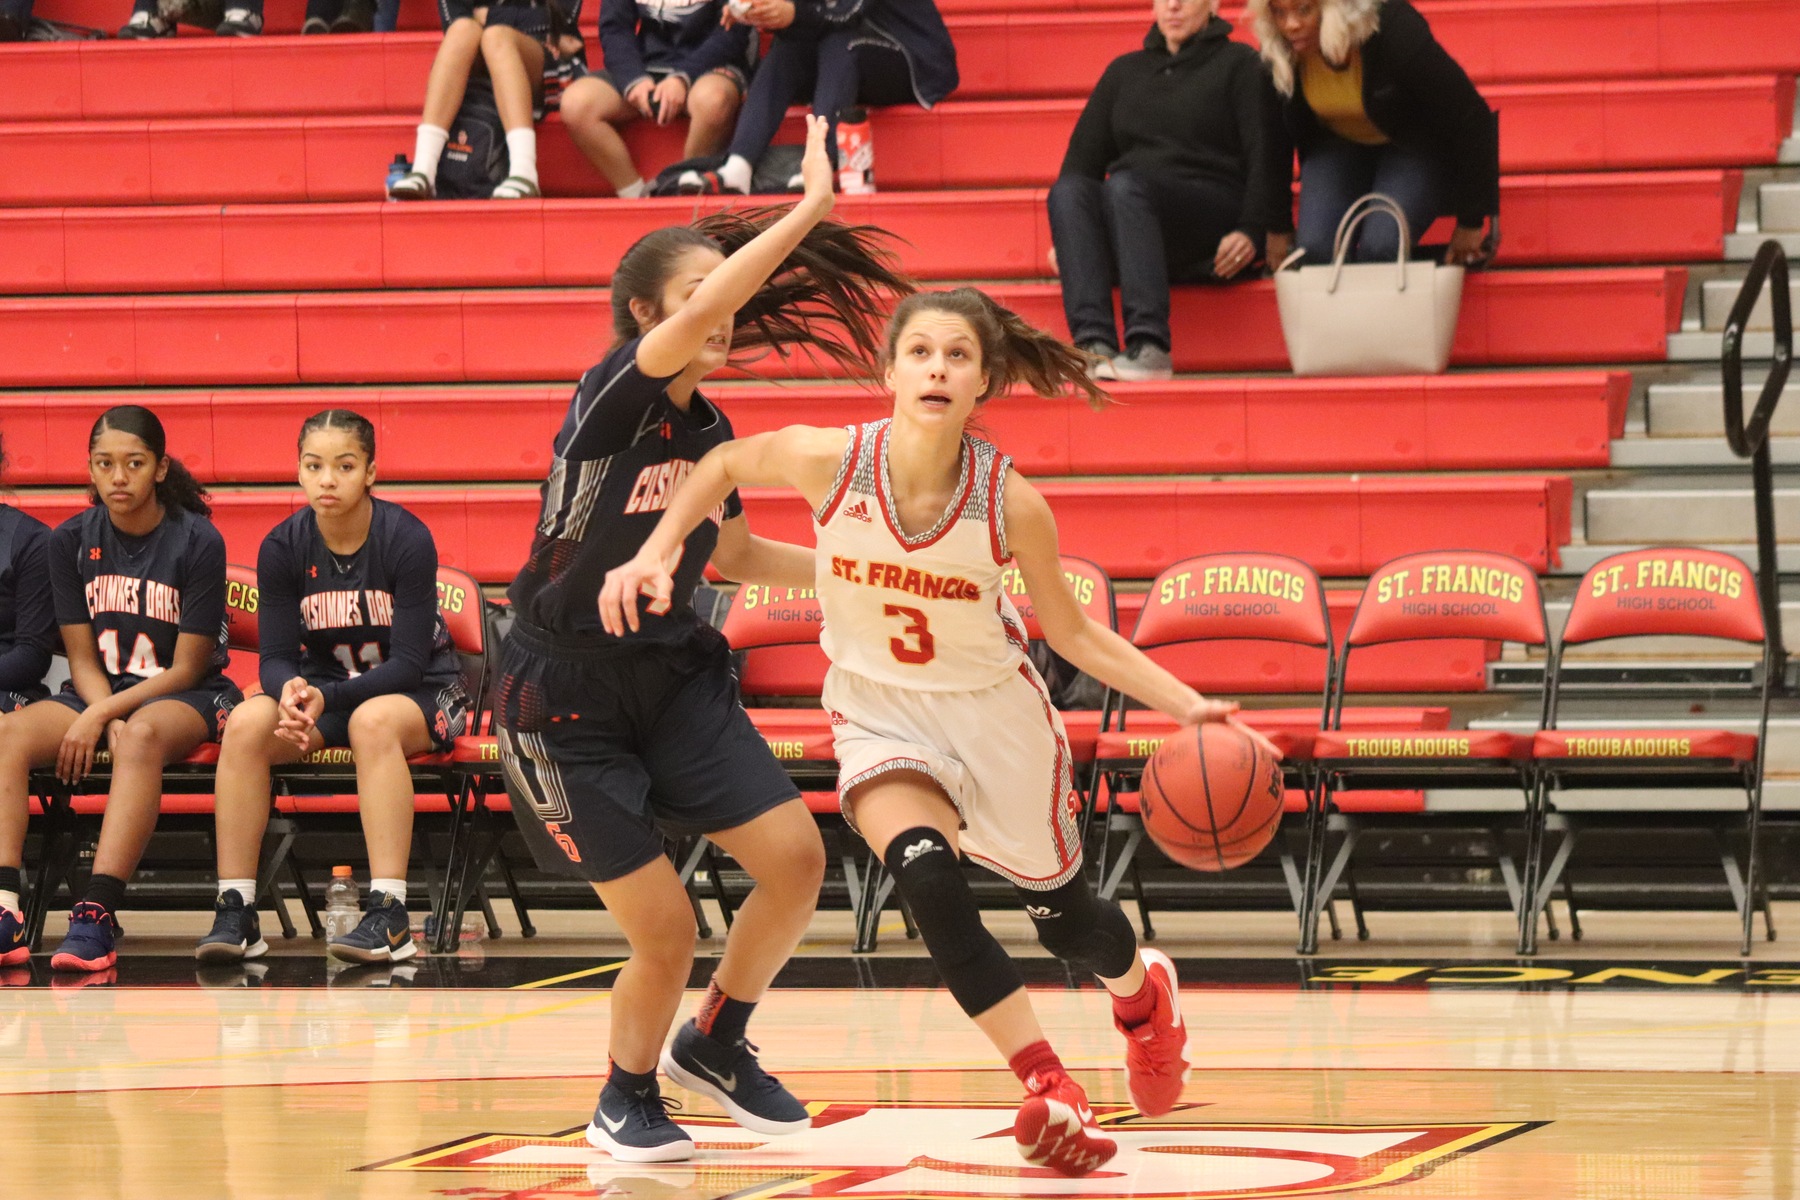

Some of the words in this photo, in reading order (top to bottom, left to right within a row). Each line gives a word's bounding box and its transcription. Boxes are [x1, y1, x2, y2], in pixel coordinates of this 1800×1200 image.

[843, 509, 873, 524] adidas
[831, 555, 863, 585] ST.
[867, 562, 982, 602] FRANCIS
[1160, 572, 1197, 605] ST.
[1203, 566, 1306, 604] FRANCIS
[1377, 571, 1415, 604] ST.
[1421, 565, 1525, 603] FRANCIS
[1592, 566, 1629, 598] ST.
[1636, 560, 1742, 599] FRANCIS
[146, 579, 181, 626] OAKS
[300, 590, 364, 632] OSUMNES
[364, 589, 395, 628] OAK
[767, 609, 801, 621] HIGH
[1184, 604, 1219, 617] HIGH
[1223, 602, 1280, 617] SCHOOL
[1402, 603, 1437, 616] HIGH
[1441, 602, 1498, 616] SCHOOL
[1617, 597, 1652, 609] HIGH
[1658, 597, 1717, 611] SCHOOL
[98, 628, 167, 679] 14
[883, 603, 935, 667] 3
[1346, 739, 1470, 757] TROUBADOURS
[1565, 738, 1691, 757] TROUBADOURS
